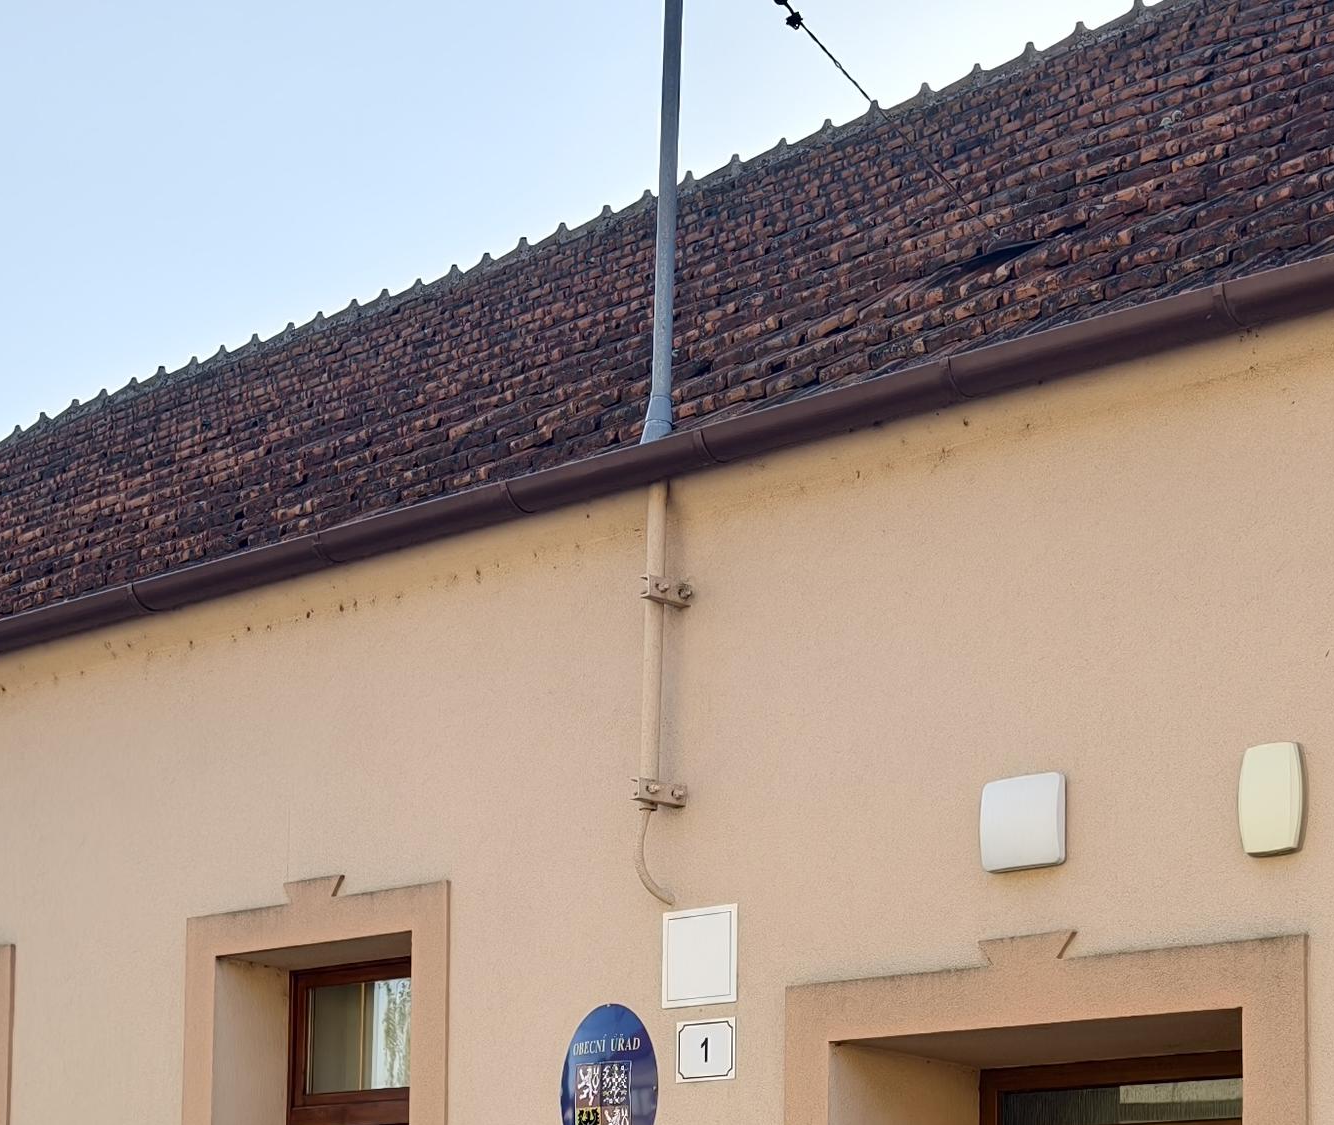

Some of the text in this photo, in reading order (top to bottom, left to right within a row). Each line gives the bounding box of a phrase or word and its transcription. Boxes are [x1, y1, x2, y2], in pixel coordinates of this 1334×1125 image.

[572, 1033, 641, 1056] OBECNÍ ÚŘAD
[700, 1037, 709, 1063] 1
